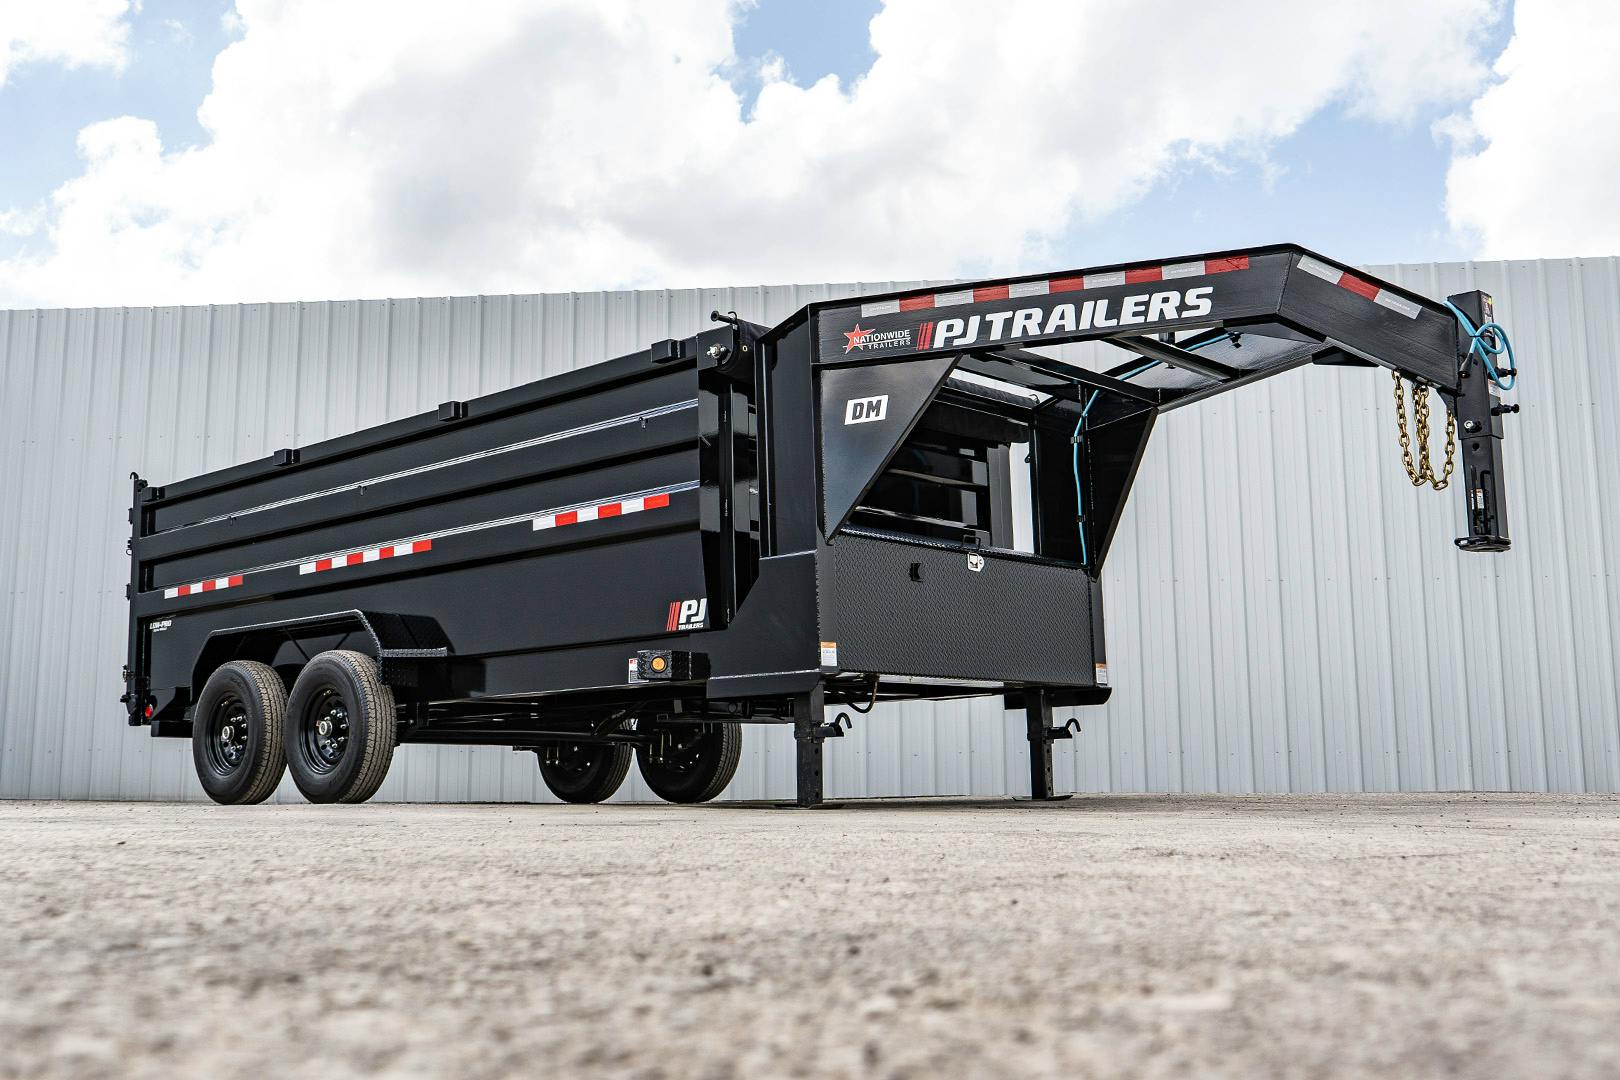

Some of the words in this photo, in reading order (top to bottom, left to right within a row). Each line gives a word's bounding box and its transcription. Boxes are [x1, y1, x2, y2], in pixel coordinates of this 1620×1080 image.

[985, 286, 1214, 341] TRAILERS
[853, 329, 911, 344] NATIONWIDE
[868, 339, 911, 350] TRAILERS
[852, 400, 882, 420] DM
[678, 598, 707, 623] PJ
